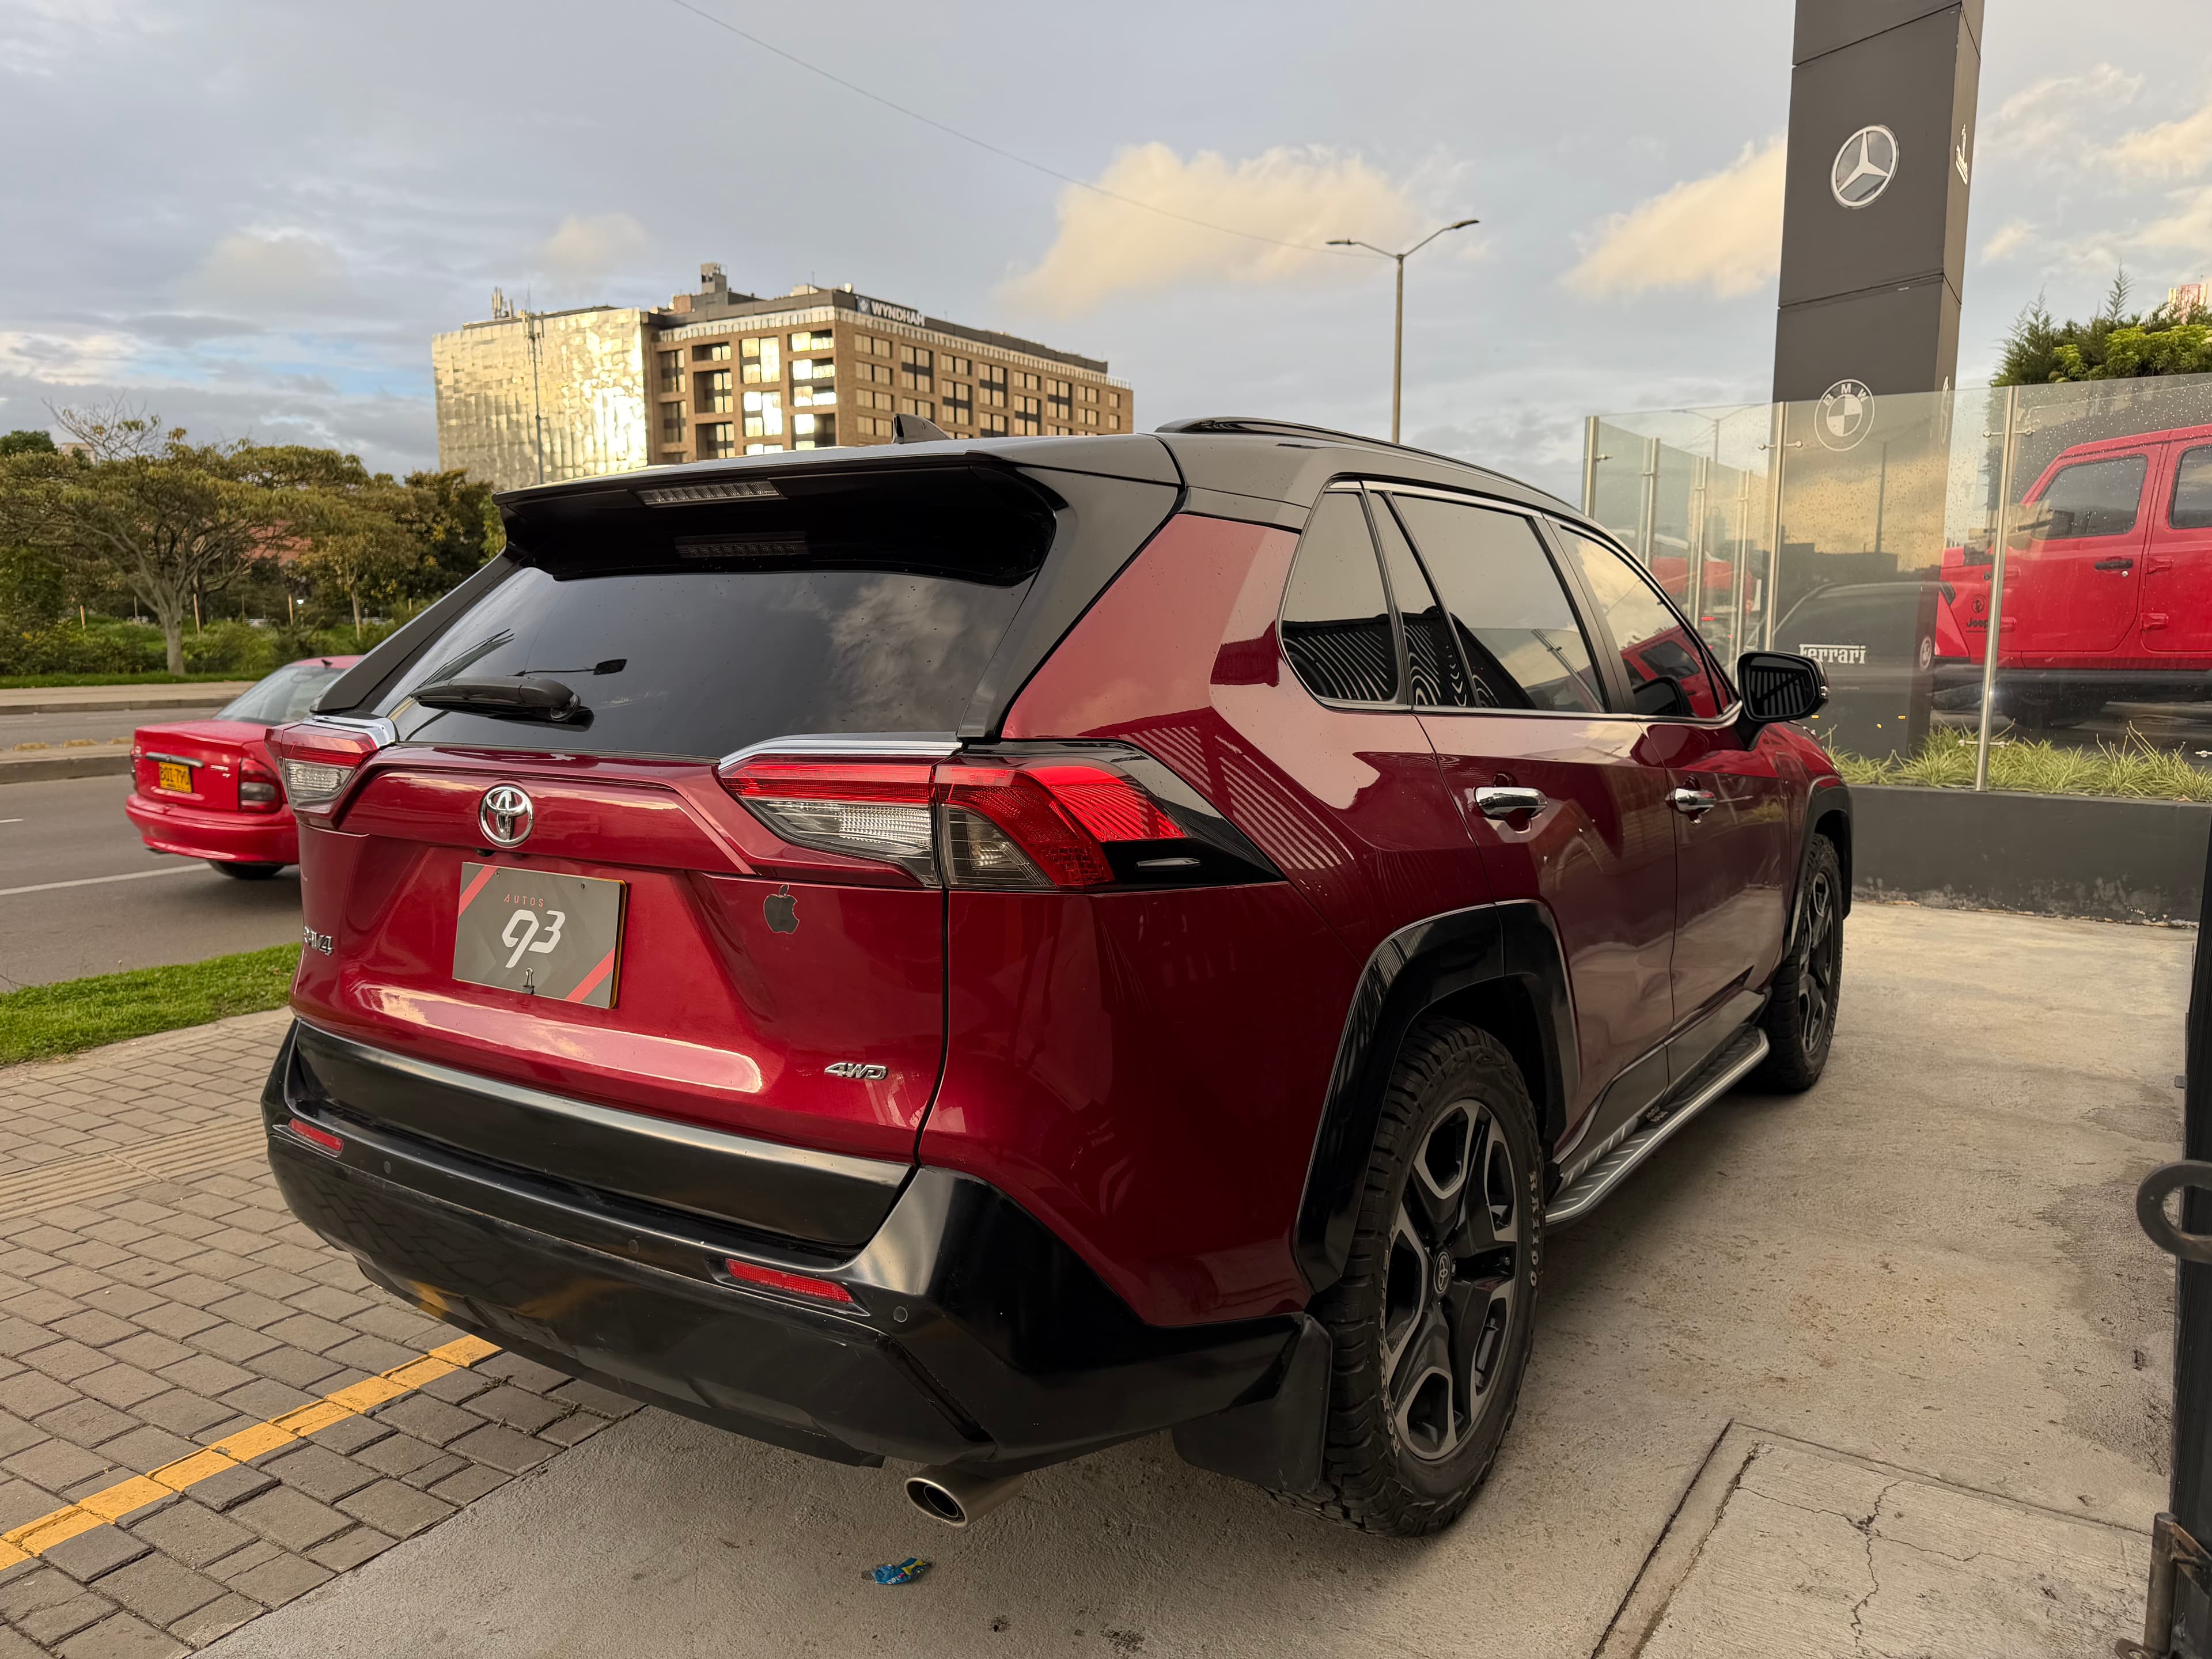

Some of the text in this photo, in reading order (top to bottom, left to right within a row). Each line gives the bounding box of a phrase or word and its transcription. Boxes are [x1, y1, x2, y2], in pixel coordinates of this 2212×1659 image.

[870, 301, 925, 327] WYNDHAM
[1799, 643, 1867, 664] Ferrari
[503, 894, 544, 908] AUTOS
[502, 909, 566, 968] 93
[824, 1062, 888, 1081] 4WD
